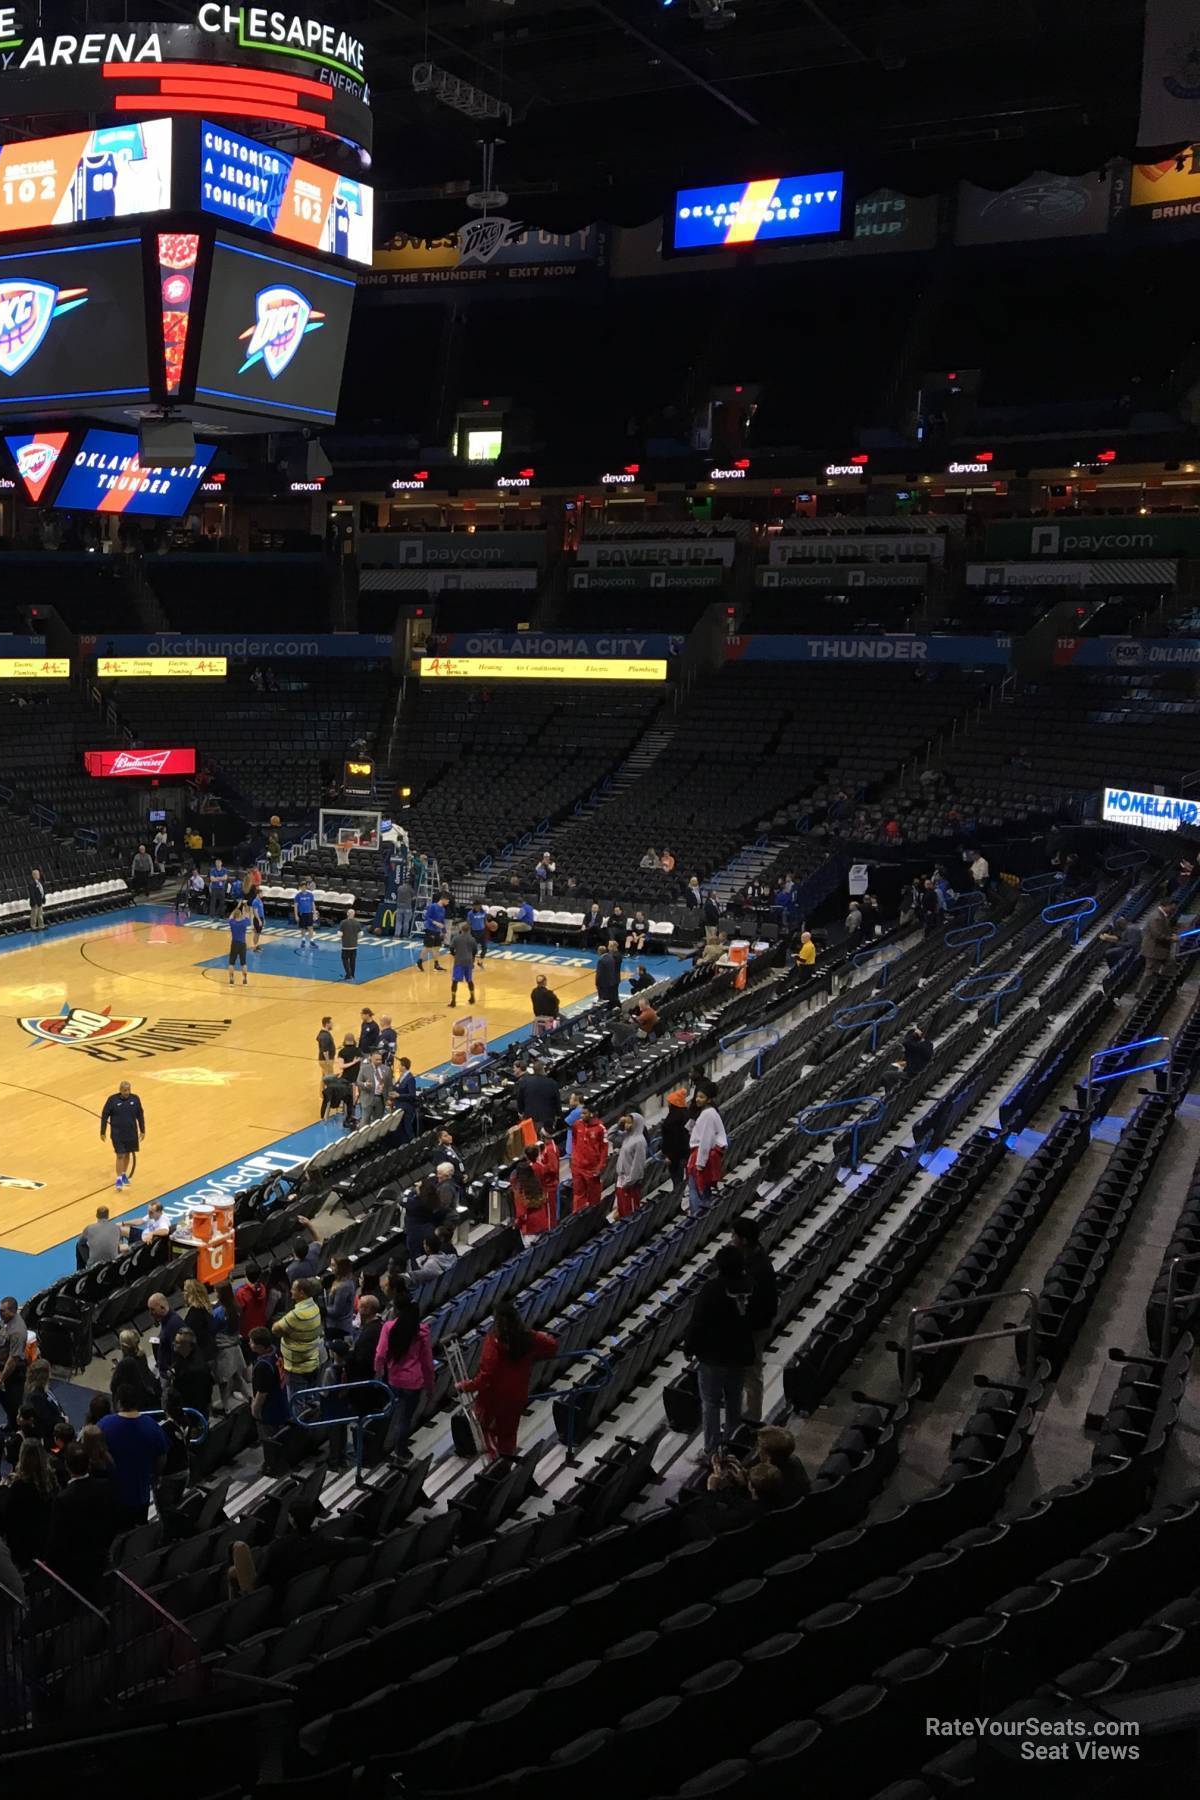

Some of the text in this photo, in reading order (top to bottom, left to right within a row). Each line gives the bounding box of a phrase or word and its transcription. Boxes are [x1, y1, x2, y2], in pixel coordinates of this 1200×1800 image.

[198, 3, 364, 71] CHESAPEAKE
[19, 33, 163, 68] ARENA
[319, 67, 362, 97] ENERGY
[204, 158, 269, 194] A JERSEY
[3, 178, 56, 205] 102
[293, 195, 321, 224] 102
[679, 190, 837, 219] OKLAHA CITY
[713, 207, 800, 228] THDER
[392, 272, 423, 283] THE
[424, 269, 487, 281] THUNDER
[508, 266, 540, 278] EXIT
[544, 264, 576, 276] NOW
[711, 467, 746, 480] devon
[826, 463, 864, 476] devon
[949, 461, 988, 474] devon
[98, 474, 171, 495] THUNDER
[291, 480, 322, 491] devon
[392, 478, 425, 490] devon
[497, 476, 531, 488] devon
[602, 472, 636, 484] devon
[1063, 533, 1155, 552] paycom
[426, 547, 502, 562] paycom
[589, 575, 636, 588] paycom
[866, 575, 921, 586] paycom
[146, 638, 320, 657] okcthunder.com
[465, 638, 589, 656] OKLAHOMA
[595, 638, 649, 656] CITY
[807, 640, 929, 660] THUNDER
[1057, 638, 1075, 649] 112
[115, 757, 164, 769] Budweiser
[1107, 791, 1200, 822] HOMELAND
[67, 1018, 233, 1062] THUNDER
